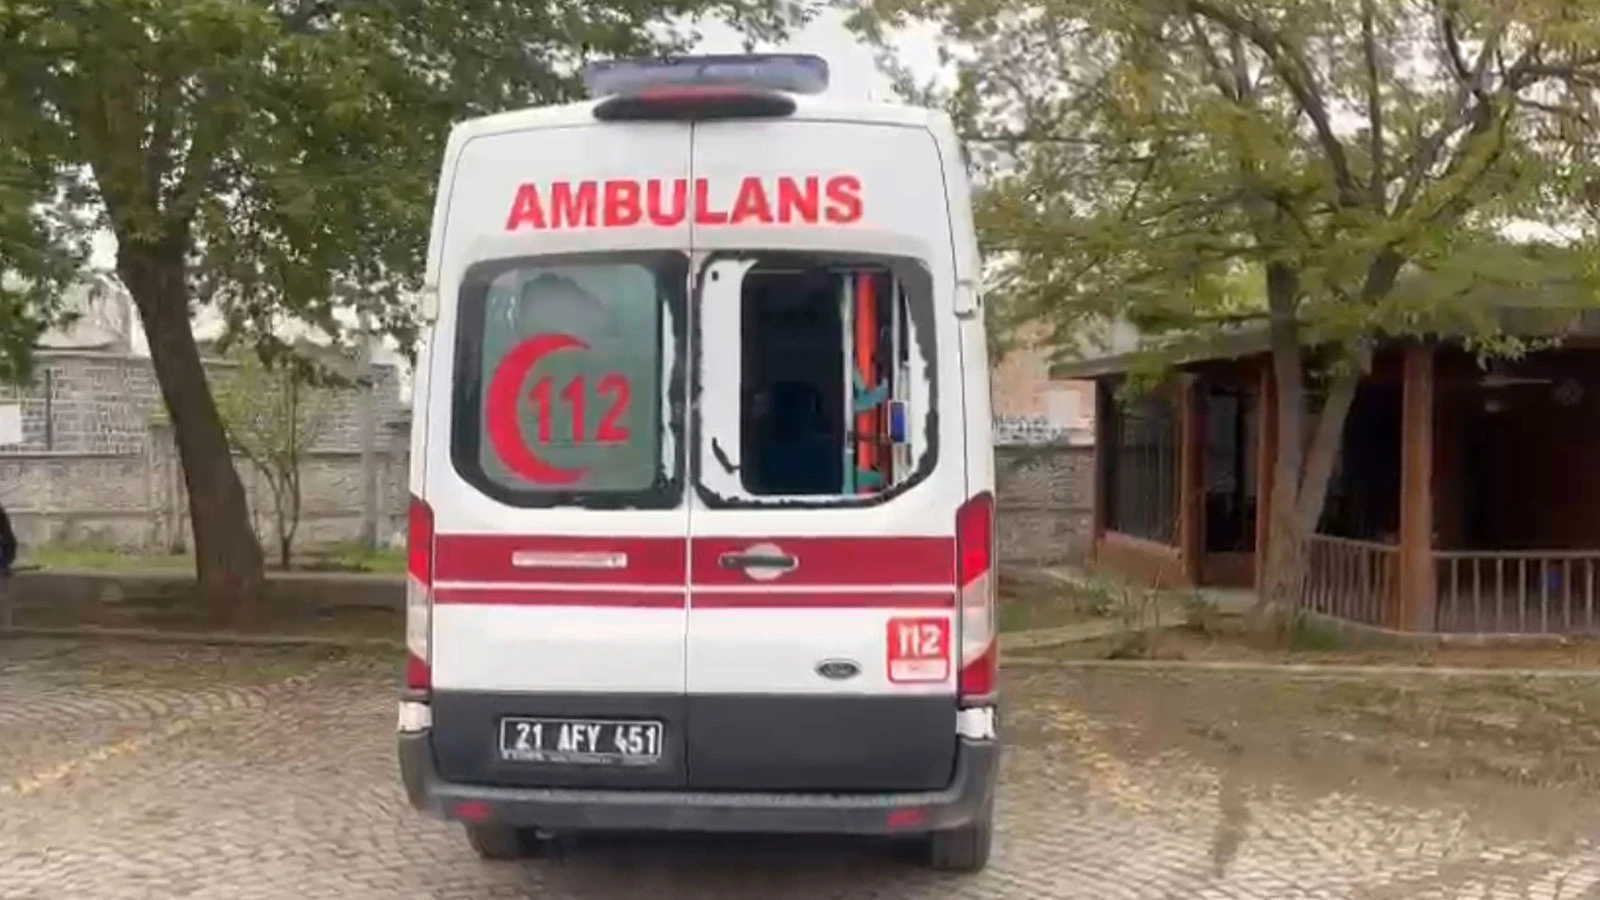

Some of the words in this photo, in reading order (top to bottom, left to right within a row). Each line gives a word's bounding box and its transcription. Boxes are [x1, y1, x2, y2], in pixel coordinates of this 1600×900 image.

[505, 174, 863, 230] AMBULANS
[528, 373, 631, 446] 112
[899, 623, 942, 657] 112
[515, 722, 543, 751] 21
[557, 723, 601, 753] AFY
[613, 725, 657, 755] 451
